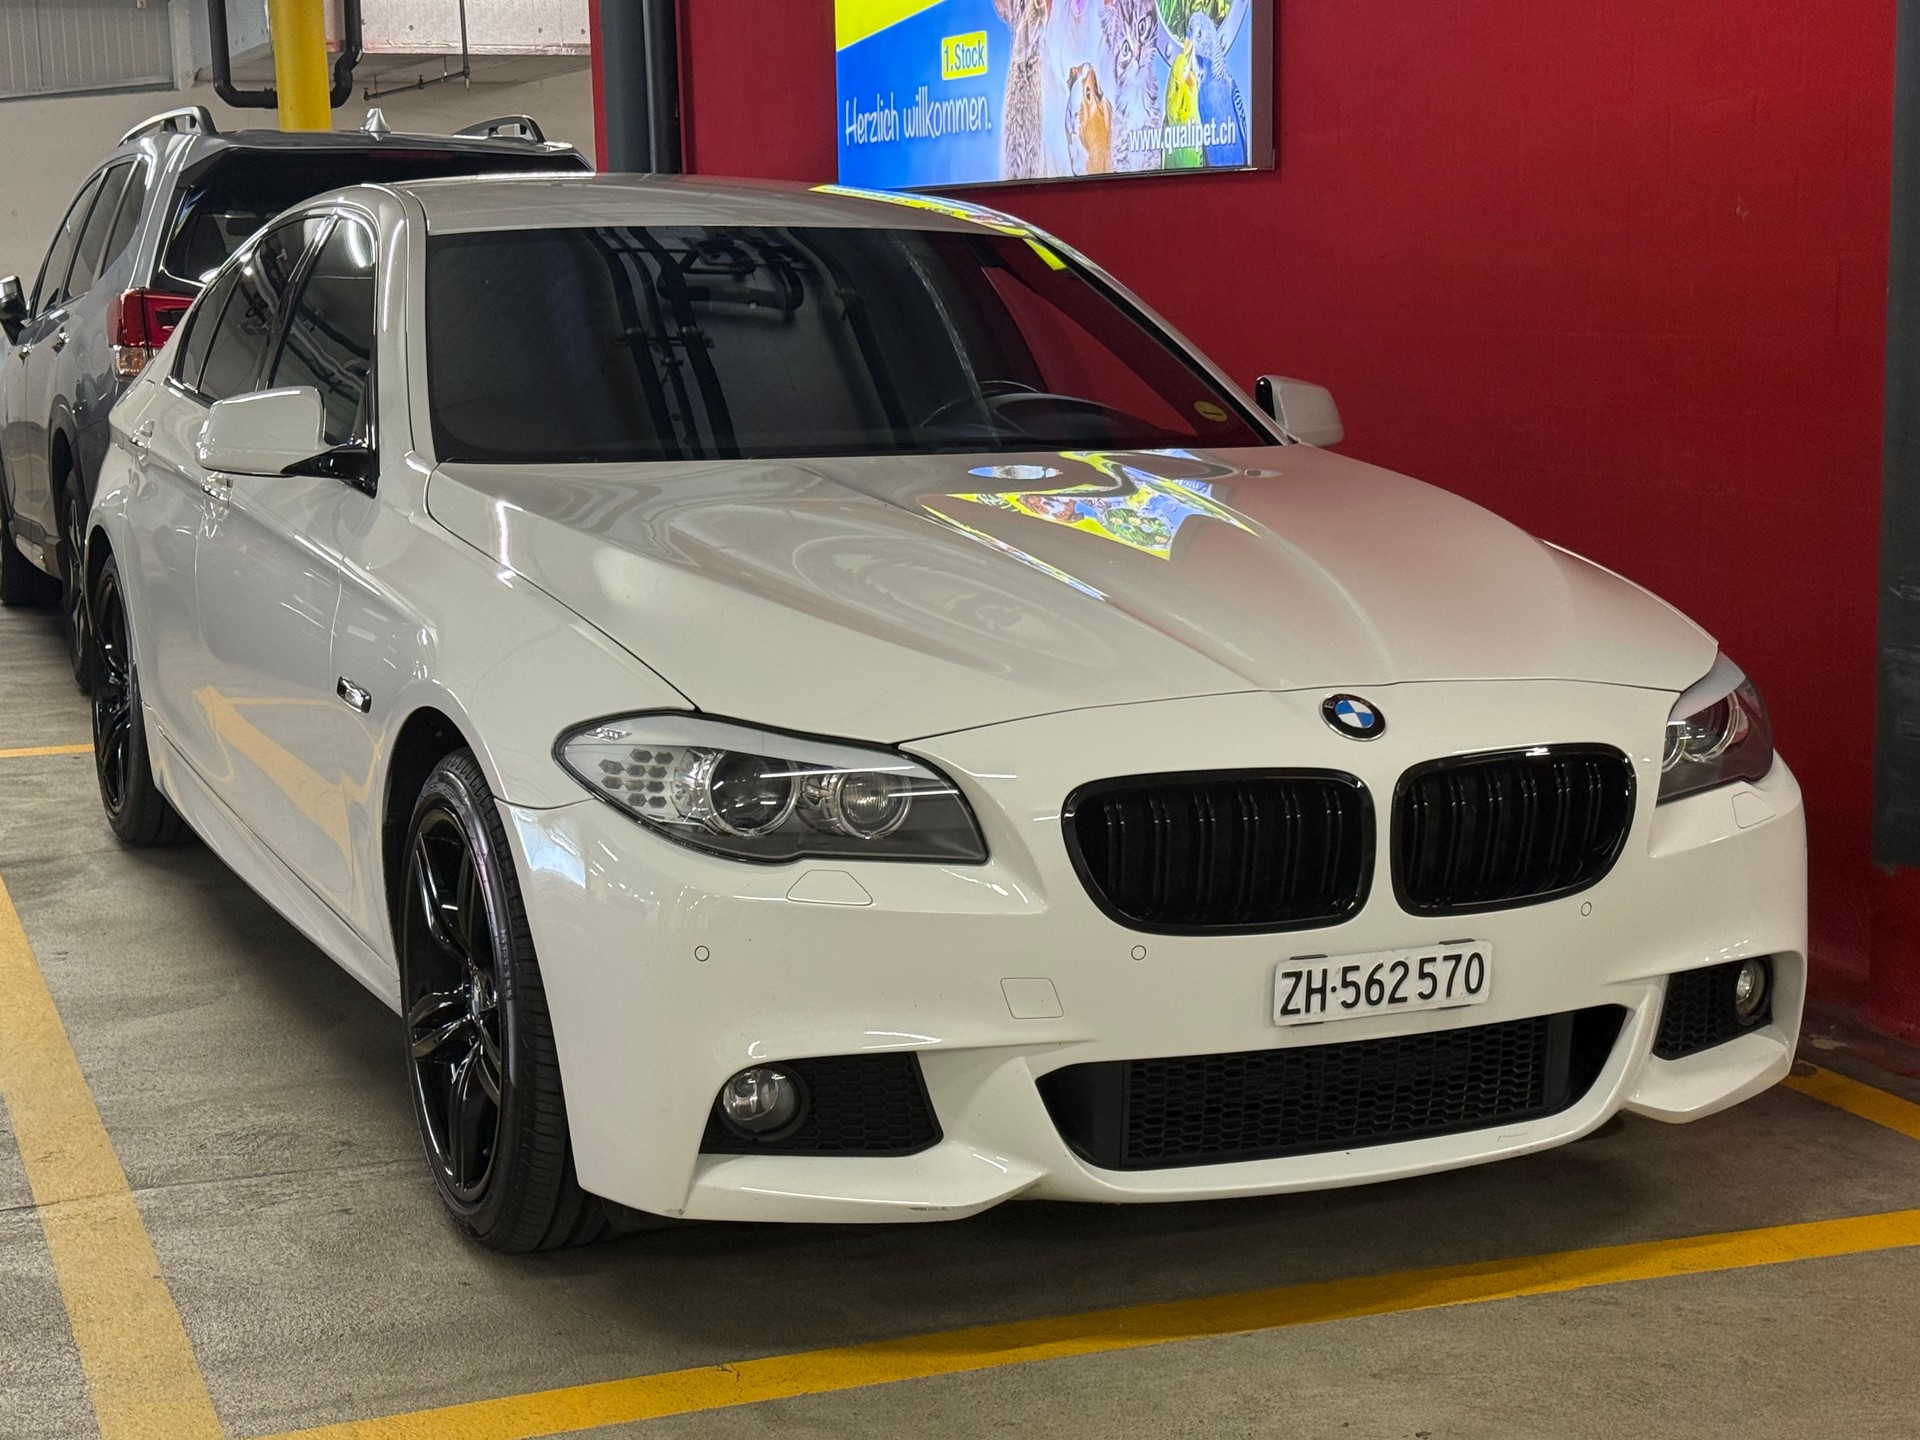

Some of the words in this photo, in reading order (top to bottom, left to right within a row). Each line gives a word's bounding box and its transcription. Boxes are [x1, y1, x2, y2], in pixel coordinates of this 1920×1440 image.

[845, 91, 900, 147] Herzlich
[903, 85, 992, 140] willkommen.
[1129, 115, 1236, 155] www.qualipet.ch
